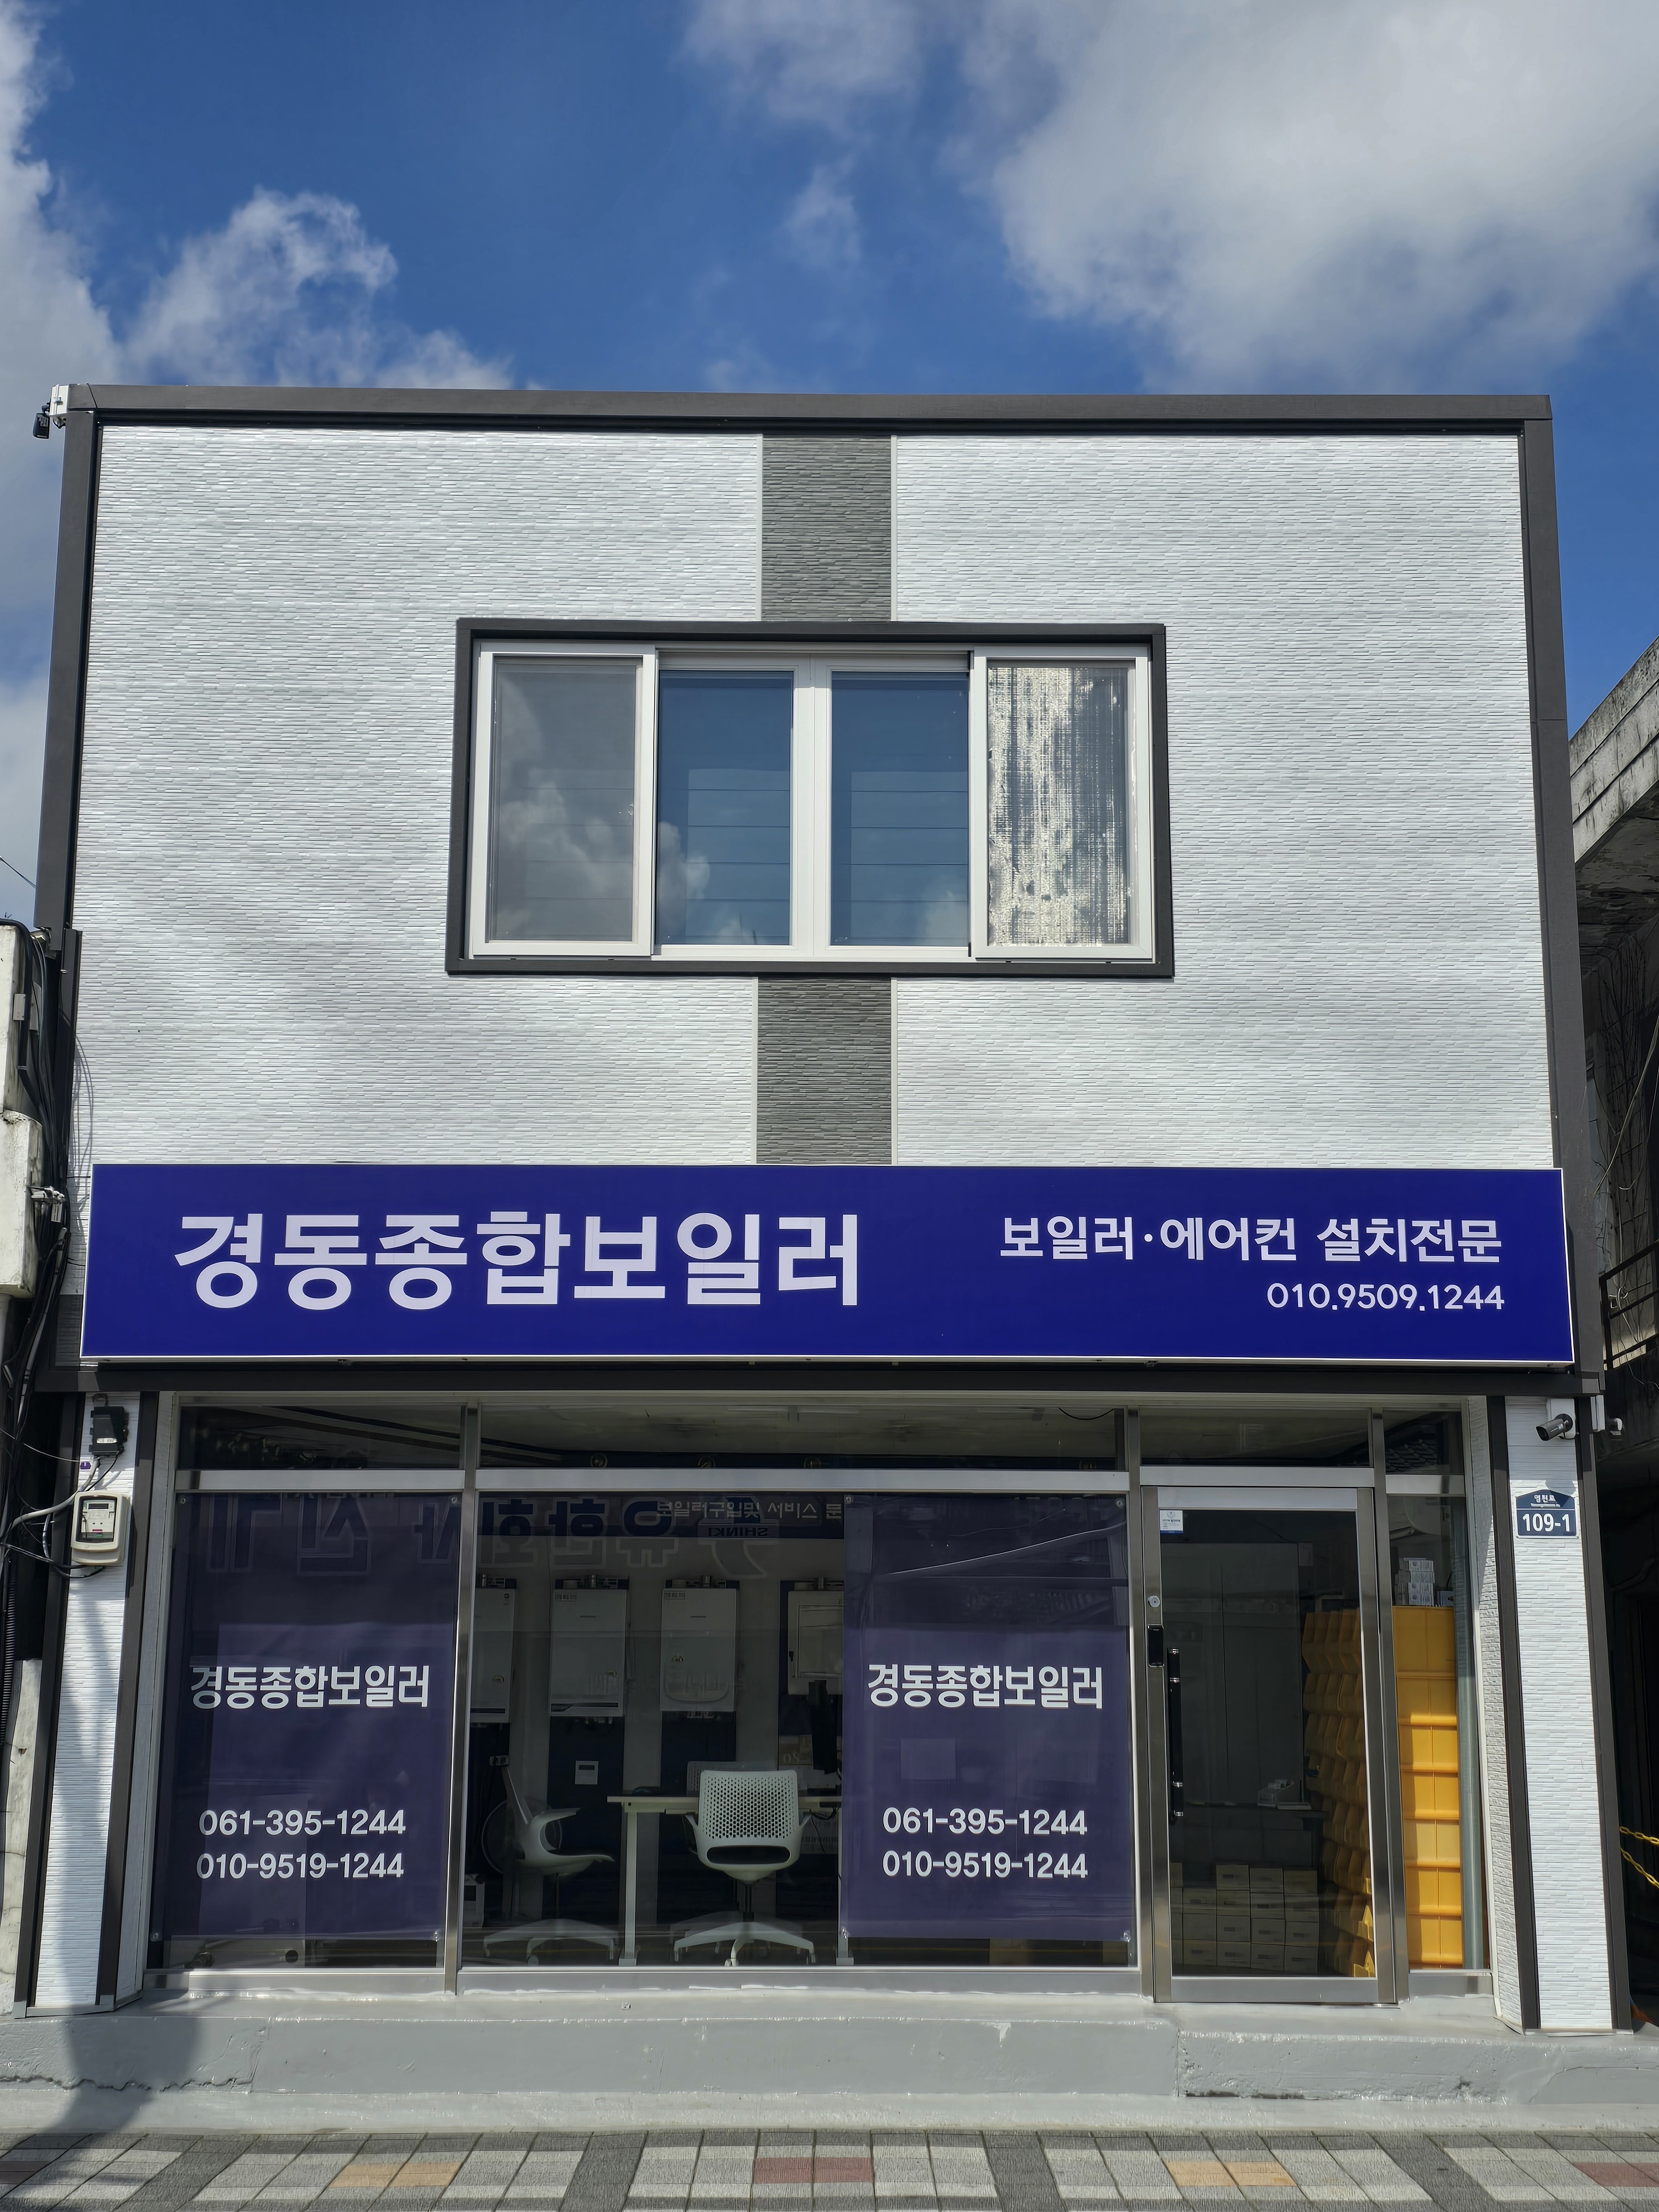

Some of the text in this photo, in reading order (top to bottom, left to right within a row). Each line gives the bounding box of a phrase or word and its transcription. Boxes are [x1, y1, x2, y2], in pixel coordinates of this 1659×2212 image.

[999, 1215, 1503, 1263] 보일러·에어컨 설치전문
[174, 1211, 858, 1311] 경동종합보일러
[1266, 1282, 1505, 1312] 010.9509.1244
[768, 1503, 817, 1519] 서비스
[1522, 1513, 1571, 1532] 109-1
[191, 1665, 430, 1709] 경동종합보일러
[867, 1663, 1103, 1709] 경동종합보일러
[199, 1808, 406, 1836] 061-395-1244
[882, 1807, 1088, 1835] 061-395-1244
[196, 1852, 405, 1880] 010-9519-1244
[882, 1849, 1089, 1879] 010-9519-1244
